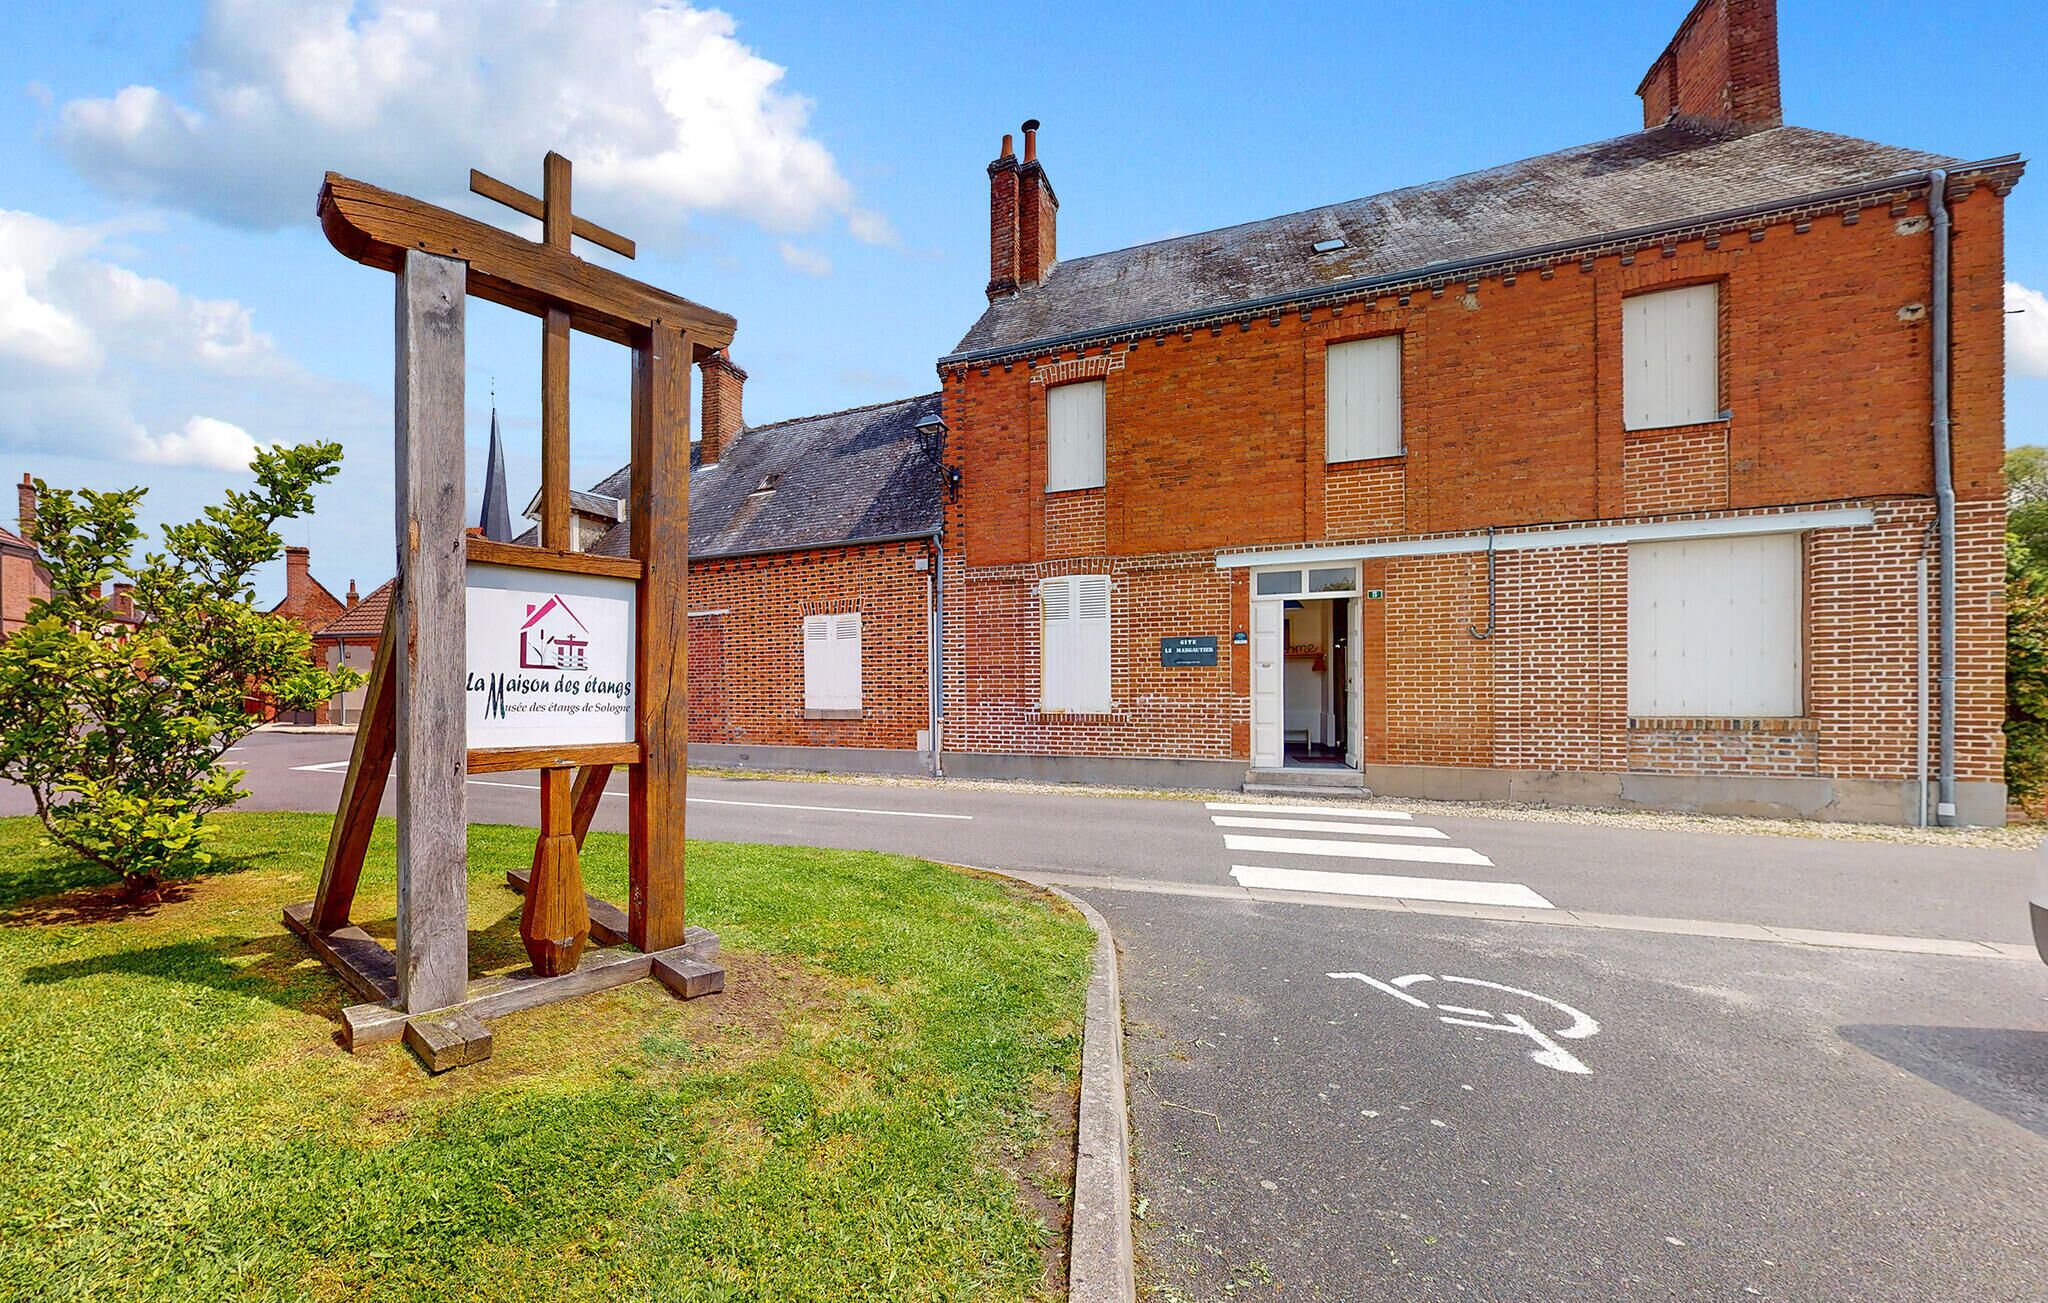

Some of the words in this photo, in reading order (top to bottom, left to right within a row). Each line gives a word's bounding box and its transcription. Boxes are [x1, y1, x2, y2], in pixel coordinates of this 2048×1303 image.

[466, 672, 485, 692] La
[484, 672, 549, 720] Maison
[554, 674, 580, 695] des
[584, 674, 631, 699] étangs
[529, 701, 546, 713] des
[548, 702, 580, 715] étangs
[582, 702, 594, 713] de
[594, 702, 631, 715] Sologne
